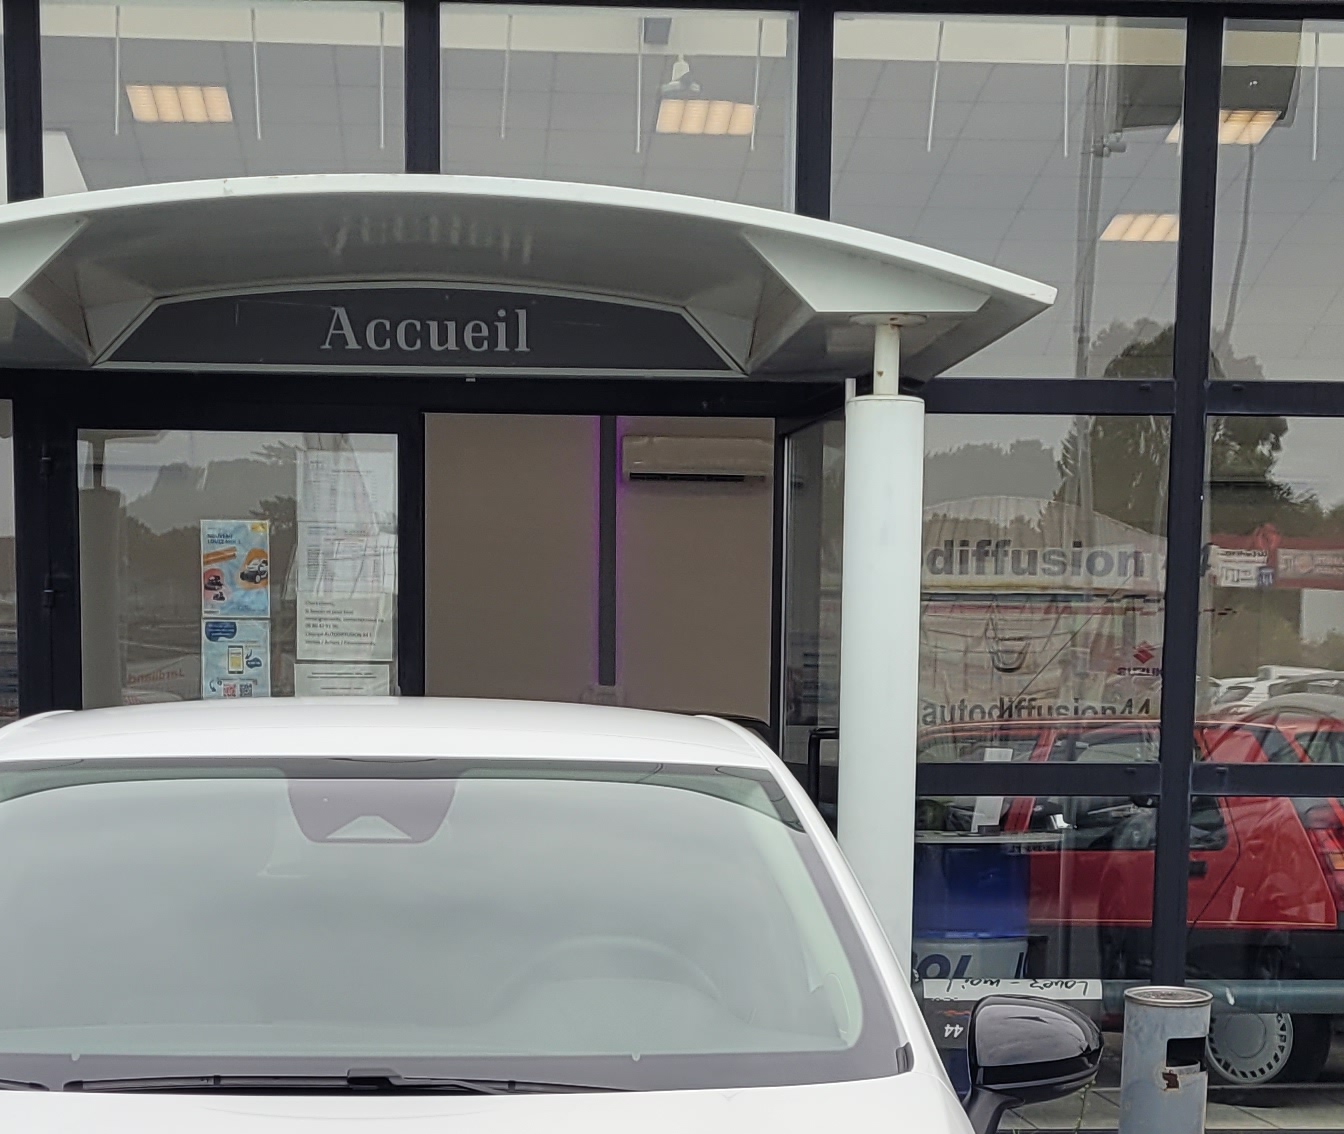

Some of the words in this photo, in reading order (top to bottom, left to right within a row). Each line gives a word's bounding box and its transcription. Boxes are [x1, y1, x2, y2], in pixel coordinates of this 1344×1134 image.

[320, 306, 531, 353] Accueil
[922, 539, 1144, 577] diffusion
[944, 1023, 964, 1038] 44
